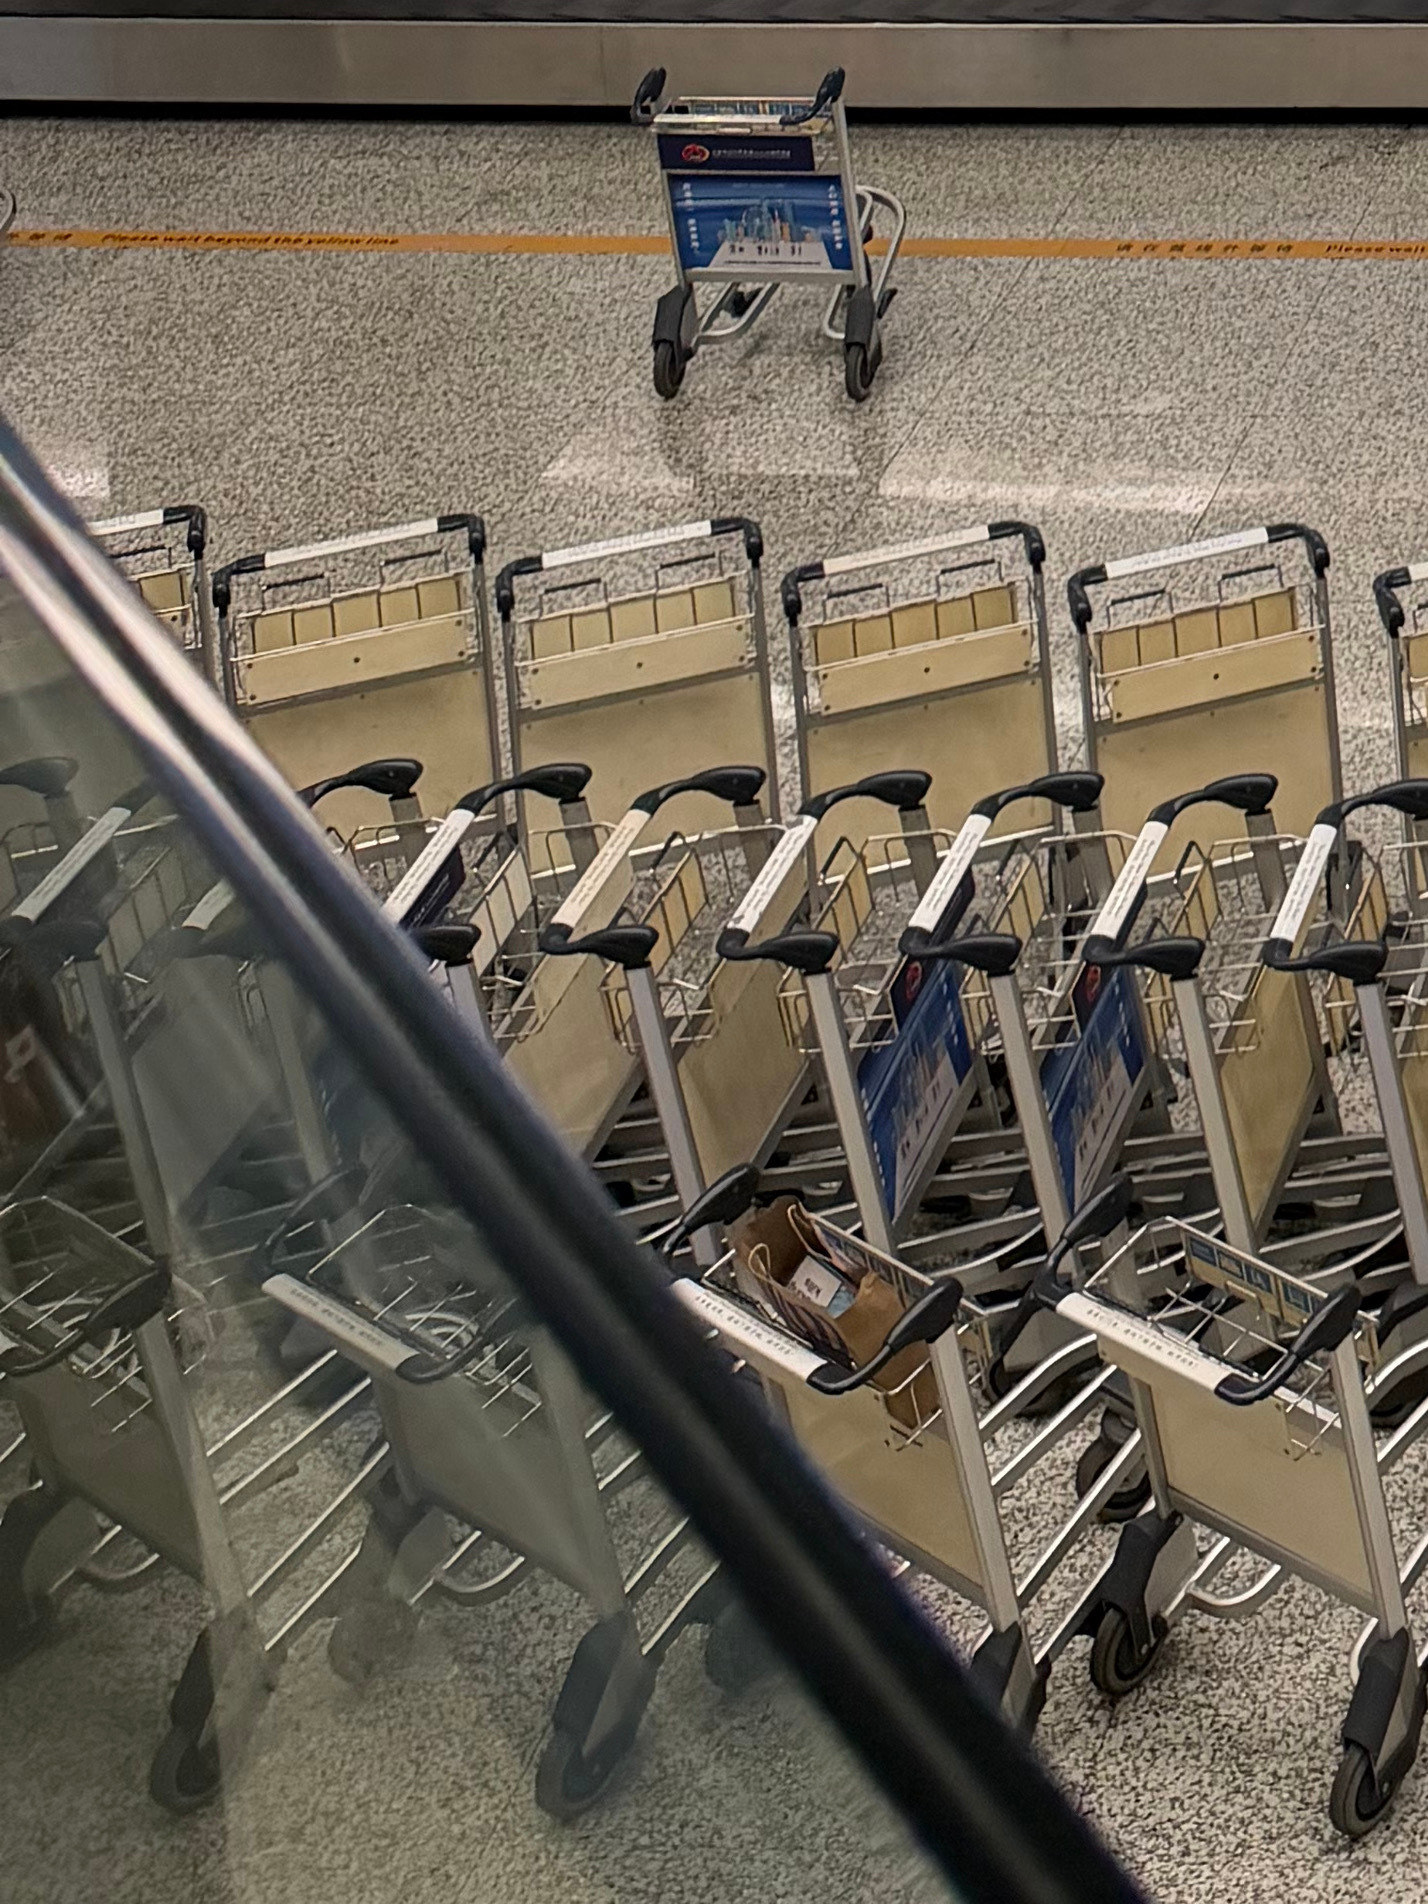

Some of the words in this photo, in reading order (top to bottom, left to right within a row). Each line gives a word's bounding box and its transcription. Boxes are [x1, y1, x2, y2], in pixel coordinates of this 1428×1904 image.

[101, 234, 159, 243] Please
[163, 234, 201, 242] wait
[1326, 244, 1384, 253] Please
[1389, 245, 1426, 253] wait
